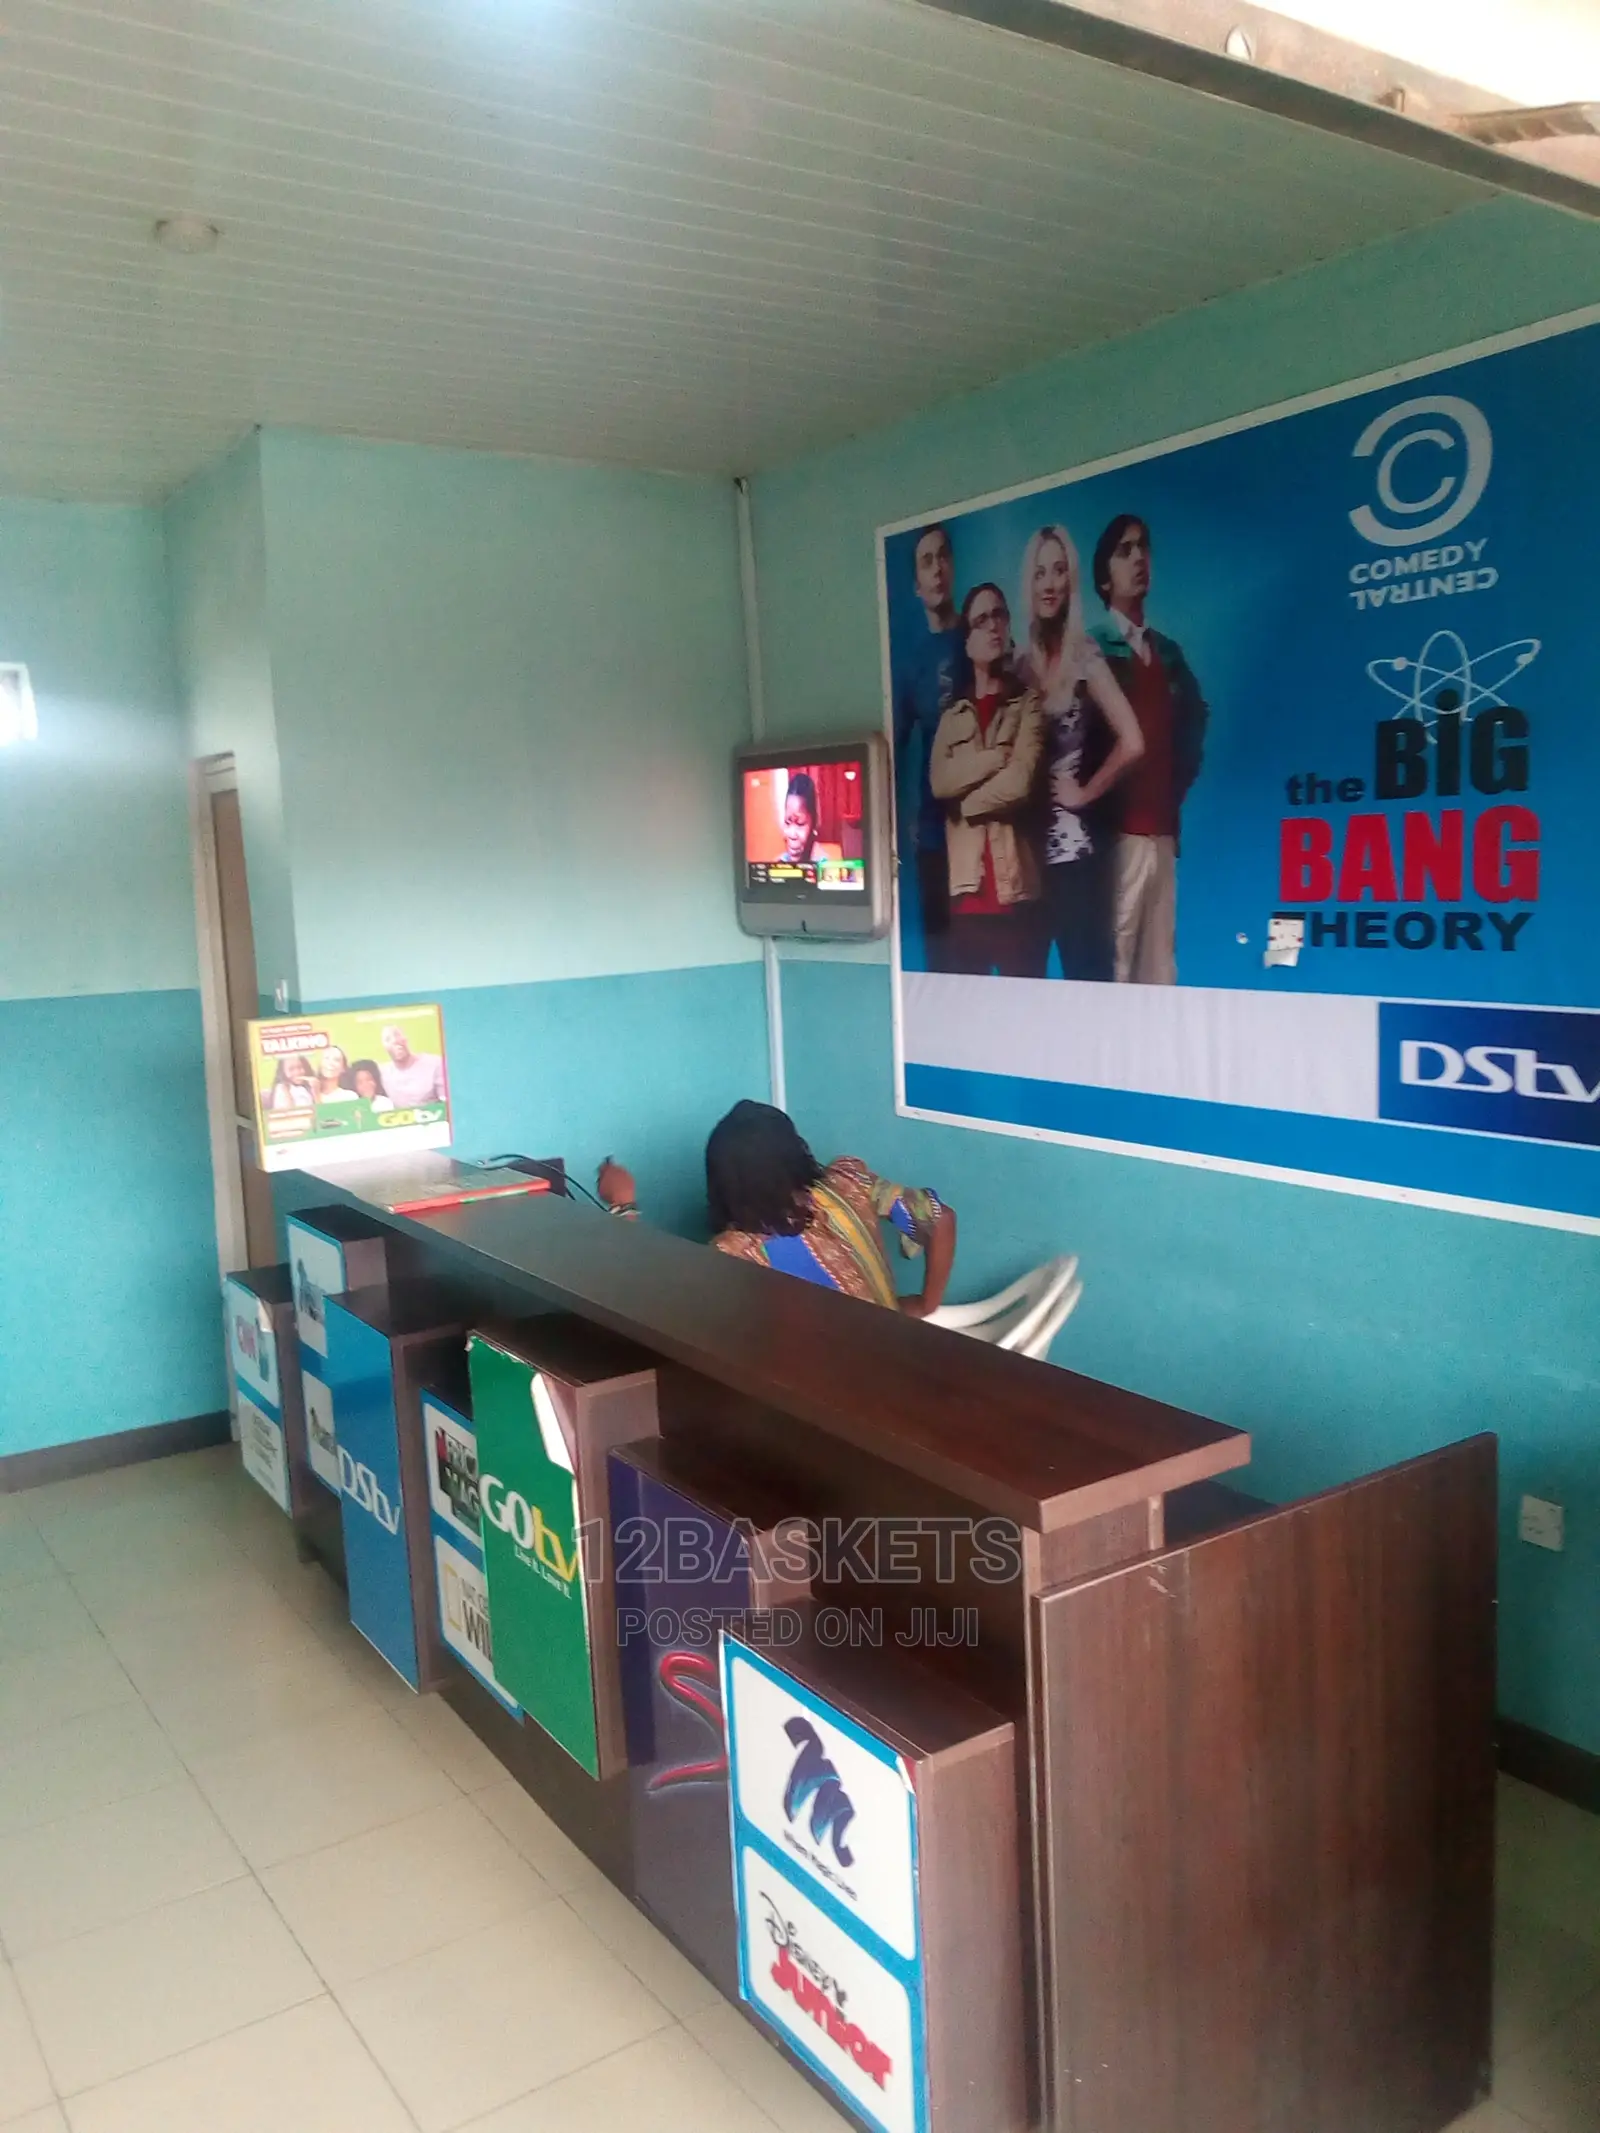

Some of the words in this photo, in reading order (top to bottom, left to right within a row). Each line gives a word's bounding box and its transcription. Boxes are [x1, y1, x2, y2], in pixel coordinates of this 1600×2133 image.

[1349, 537, 1489, 584] COMEDY
[1349, 566, 1499, 611] CENTRAL
[1285, 772, 1366, 806] the
[1375, 688, 1531, 801] BIG
[1280, 805, 1541, 904] BANG
[337, 1445, 402, 1536] DStv
[480, 1473, 579, 1583] GOtv
